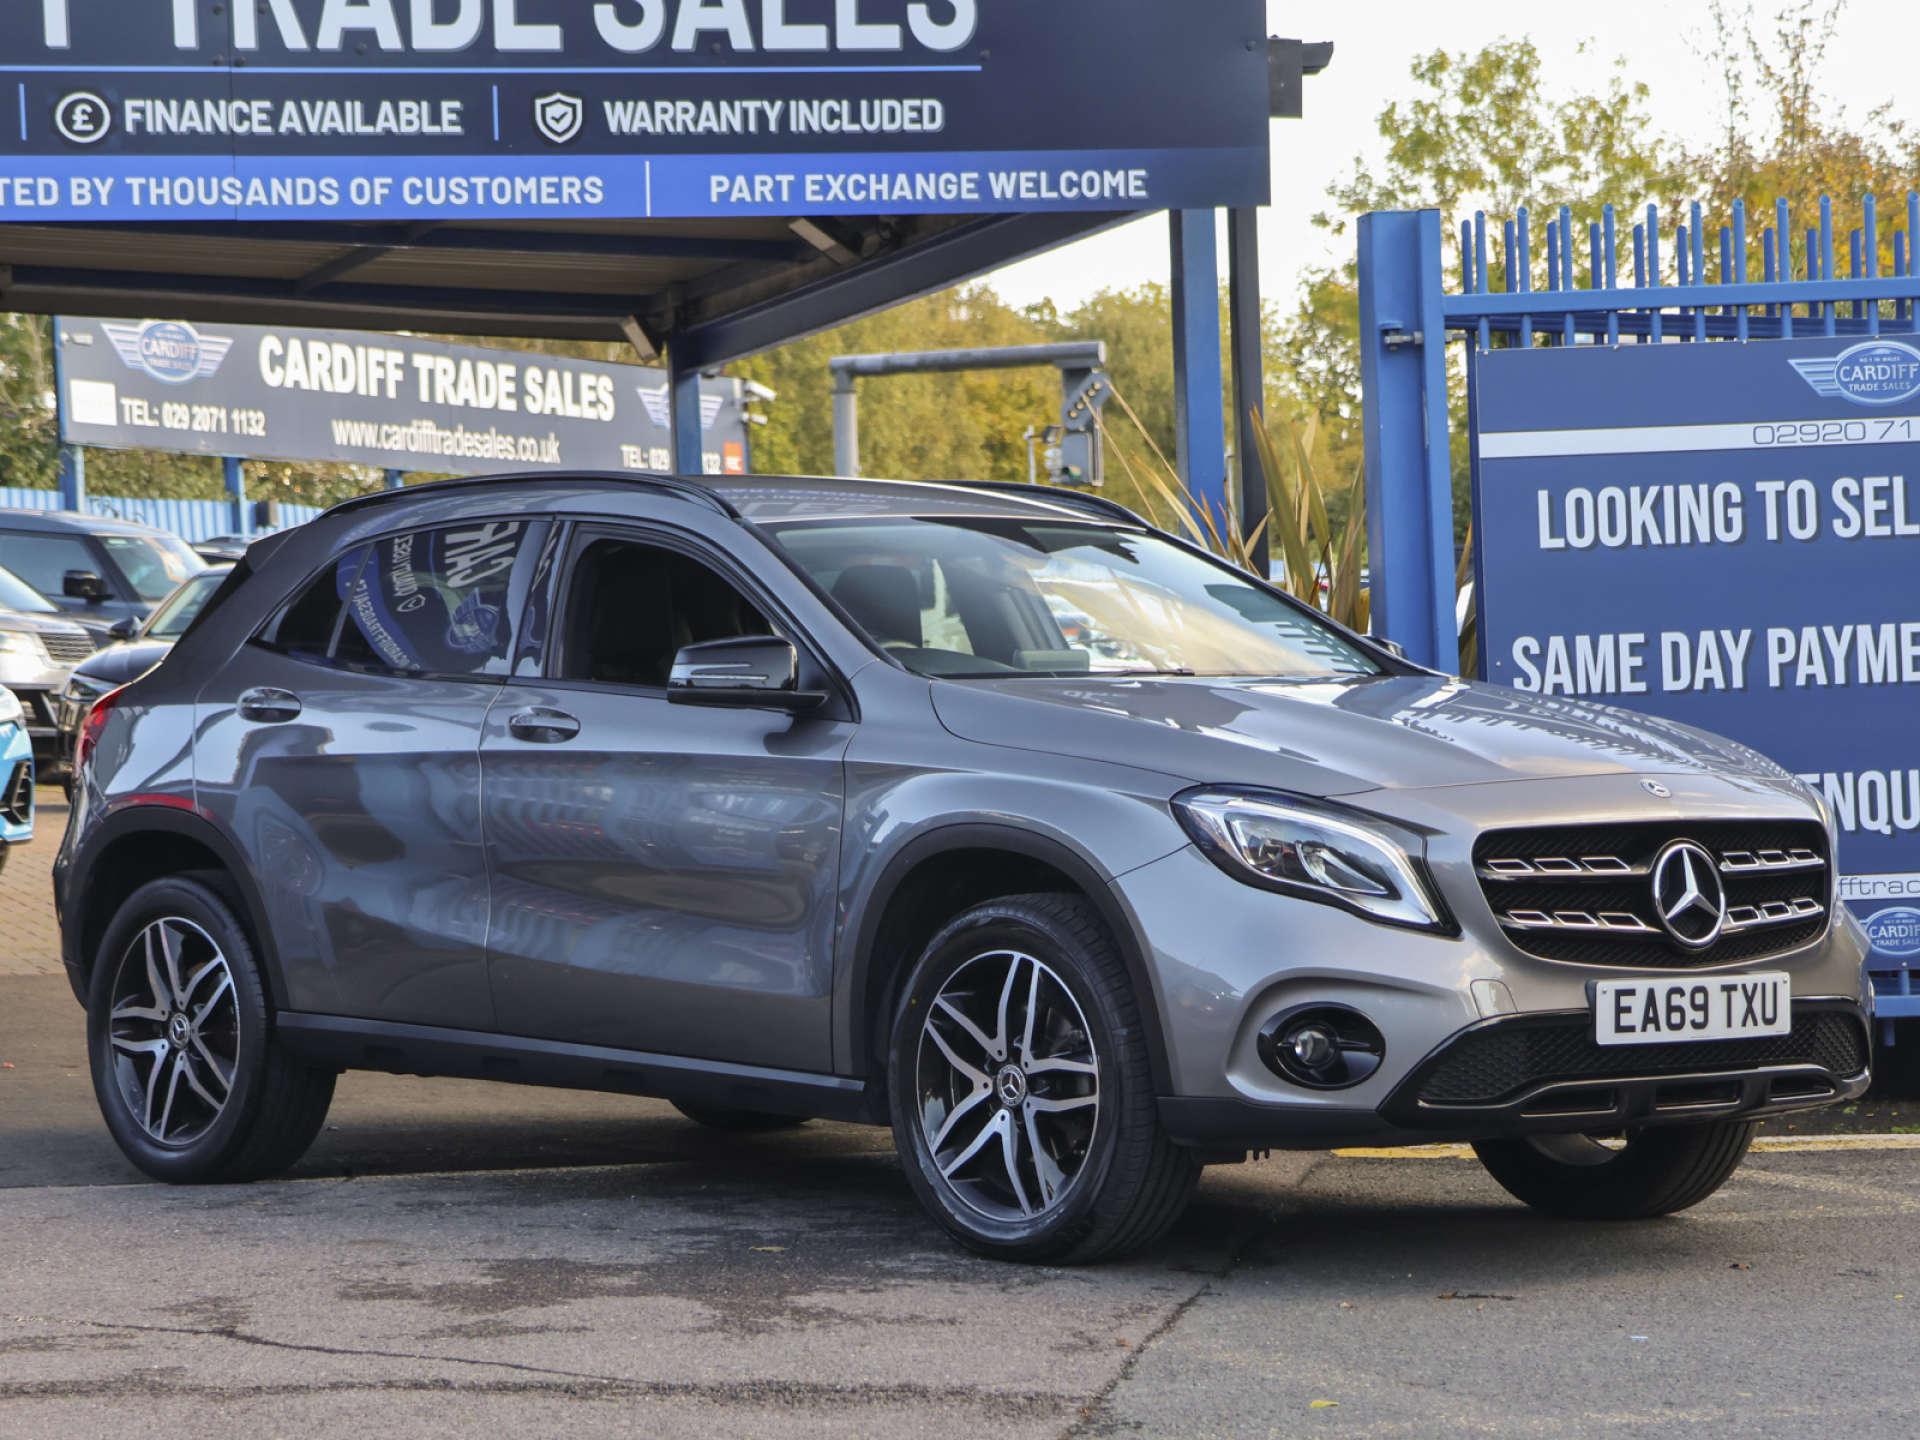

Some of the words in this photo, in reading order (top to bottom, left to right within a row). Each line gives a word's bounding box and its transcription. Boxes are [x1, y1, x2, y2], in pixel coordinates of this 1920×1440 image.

[125, 100, 272, 134] FINANCE
[279, 100, 463, 134] AVAILABLE
[603, 99, 783, 134] WARRANTY
[789, 98, 945, 133] INCLUDED
[70, 177, 115, 206] BY
[125, 177, 340, 207] THOUSANDS
[350, 177, 392, 206] OF
[402, 175, 605, 206] CUSTOMERS
[710, 173, 795, 203] PART
[804, 171, 980, 202] EXCHANGE
[988, 168, 1148, 200] WELCOME
[259, 334, 405, 400] CARDIFF
[412, 353, 518, 412] TRADE
[524, 365, 616, 422] SALES
[1840, 363, 1920, 382] CARDIFF
[1848, 383, 1879, 393] TRADE
[1882, 381, 1911, 391] SALES
[120, 397, 160, 427] TEL:
[162, 401, 190, 431] 029
[191, 404, 228, 434] 2071
[231, 407, 266, 437] 1132
[1753, 421, 1866, 446] 02920
[1873, 419, 1911, 440] 71
[331, 419, 561, 464] www.cardifftradesales.co.uk
[1537, 481, 1743, 549] LOOKING
[1755, 478, 1818, 541] TO
[1831, 475, 1920, 539] SEL
[1512, 632, 1648, 695] SAME
[1661, 628, 1752, 692] DAY
[1767, 622, 1920, 688] PAYME
[1614, 986, 1709, 1034] EA69
[1720, 981, 1778, 1029] TXU
